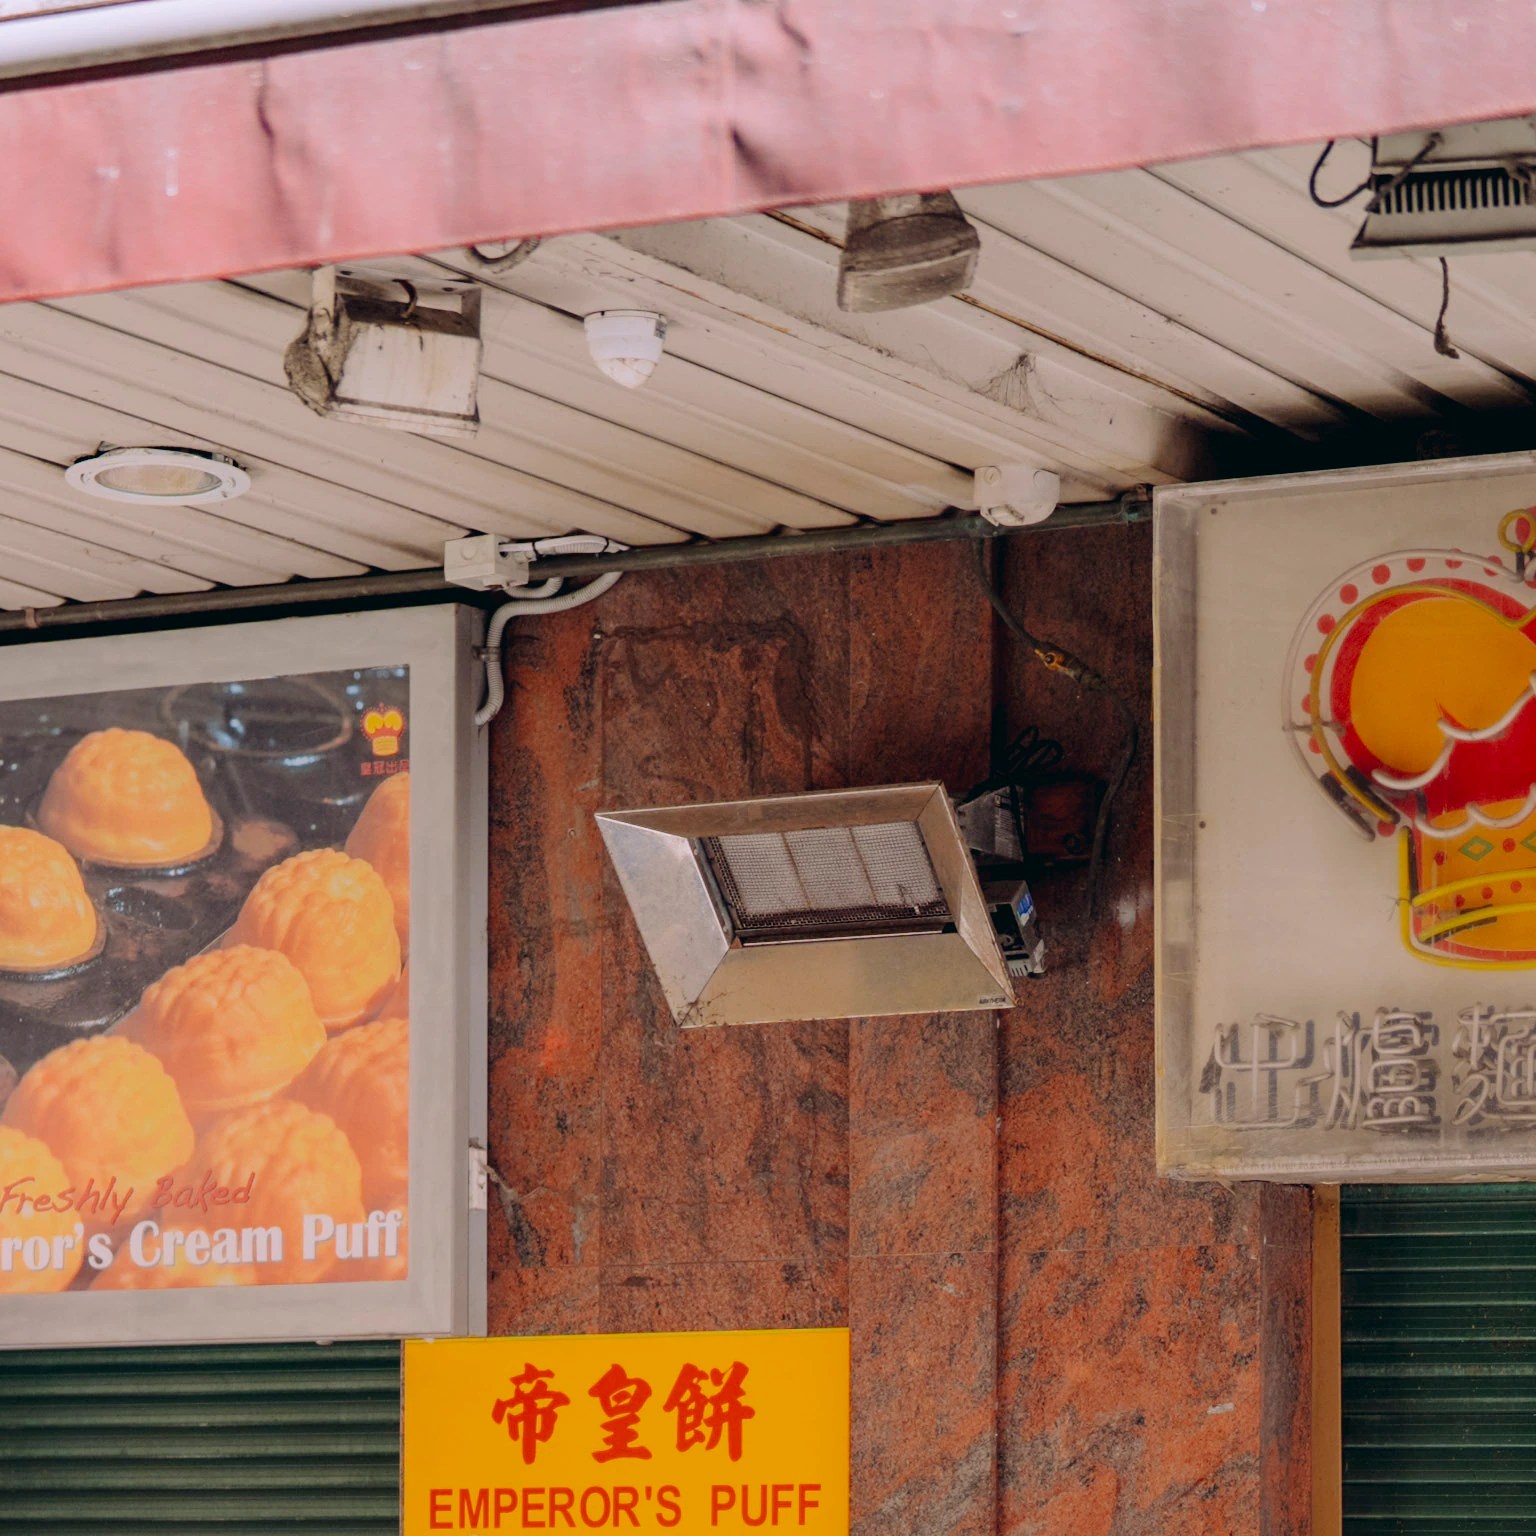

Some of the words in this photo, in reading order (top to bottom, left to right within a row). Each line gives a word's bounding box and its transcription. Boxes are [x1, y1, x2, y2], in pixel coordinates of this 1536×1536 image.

[151, 1171, 255, 1214] Baked
[129, 1221, 283, 1268] Cream
[303, 1210, 402, 1260] Puff
[491, 1361, 756, 1465] 帝皇餅
[429, 1485, 682, 1530] EMPEROR'S
[710, 1484, 822, 1527] PUFF
